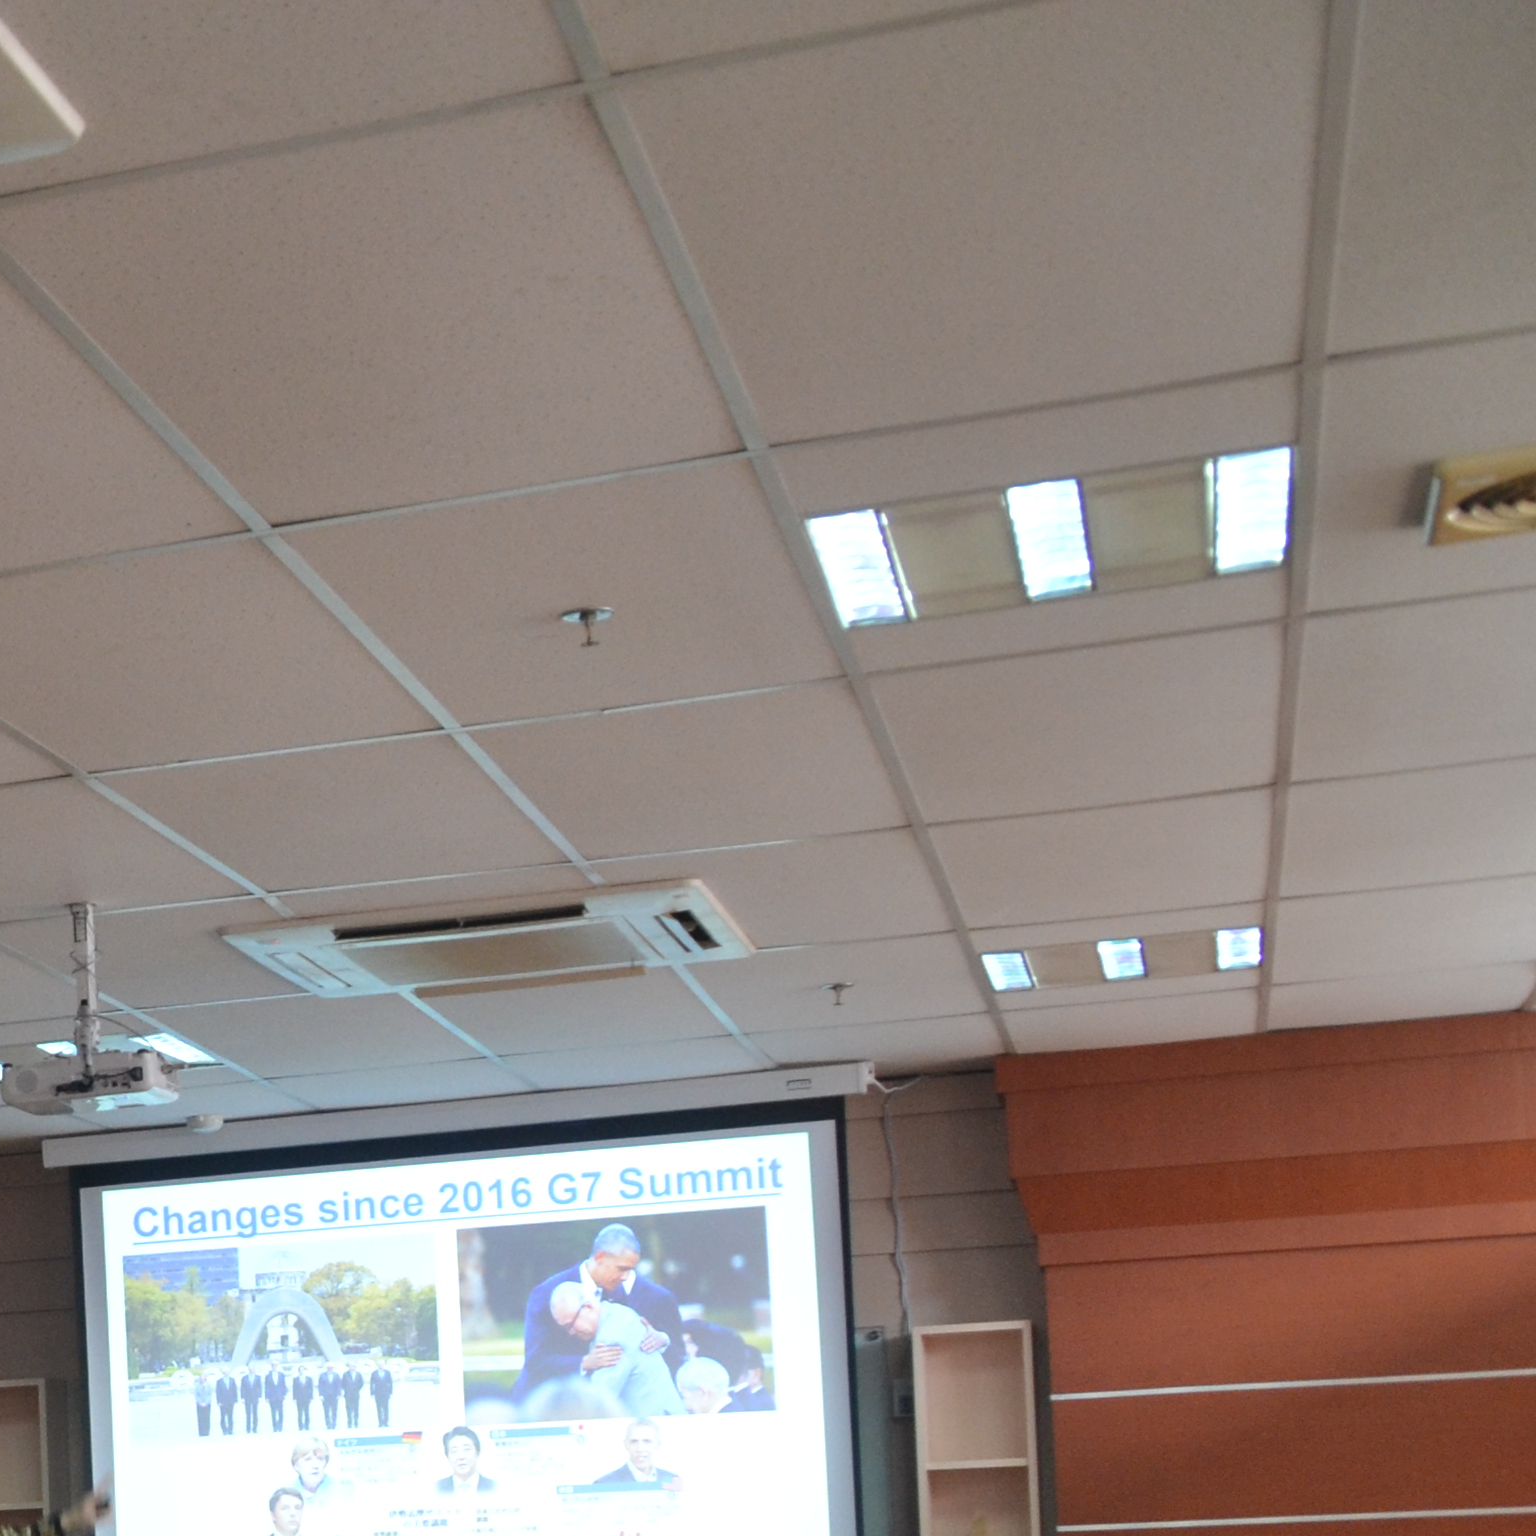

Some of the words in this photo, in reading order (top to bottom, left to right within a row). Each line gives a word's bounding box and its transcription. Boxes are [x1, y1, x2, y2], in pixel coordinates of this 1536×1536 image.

[133, 1202, 304, 1239] Changes
[319, 1191, 424, 1225] since
[439, 1175, 532, 1213] 2016
[548, 1171, 601, 1205] G7
[619, 1157, 783, 1200] Summit
